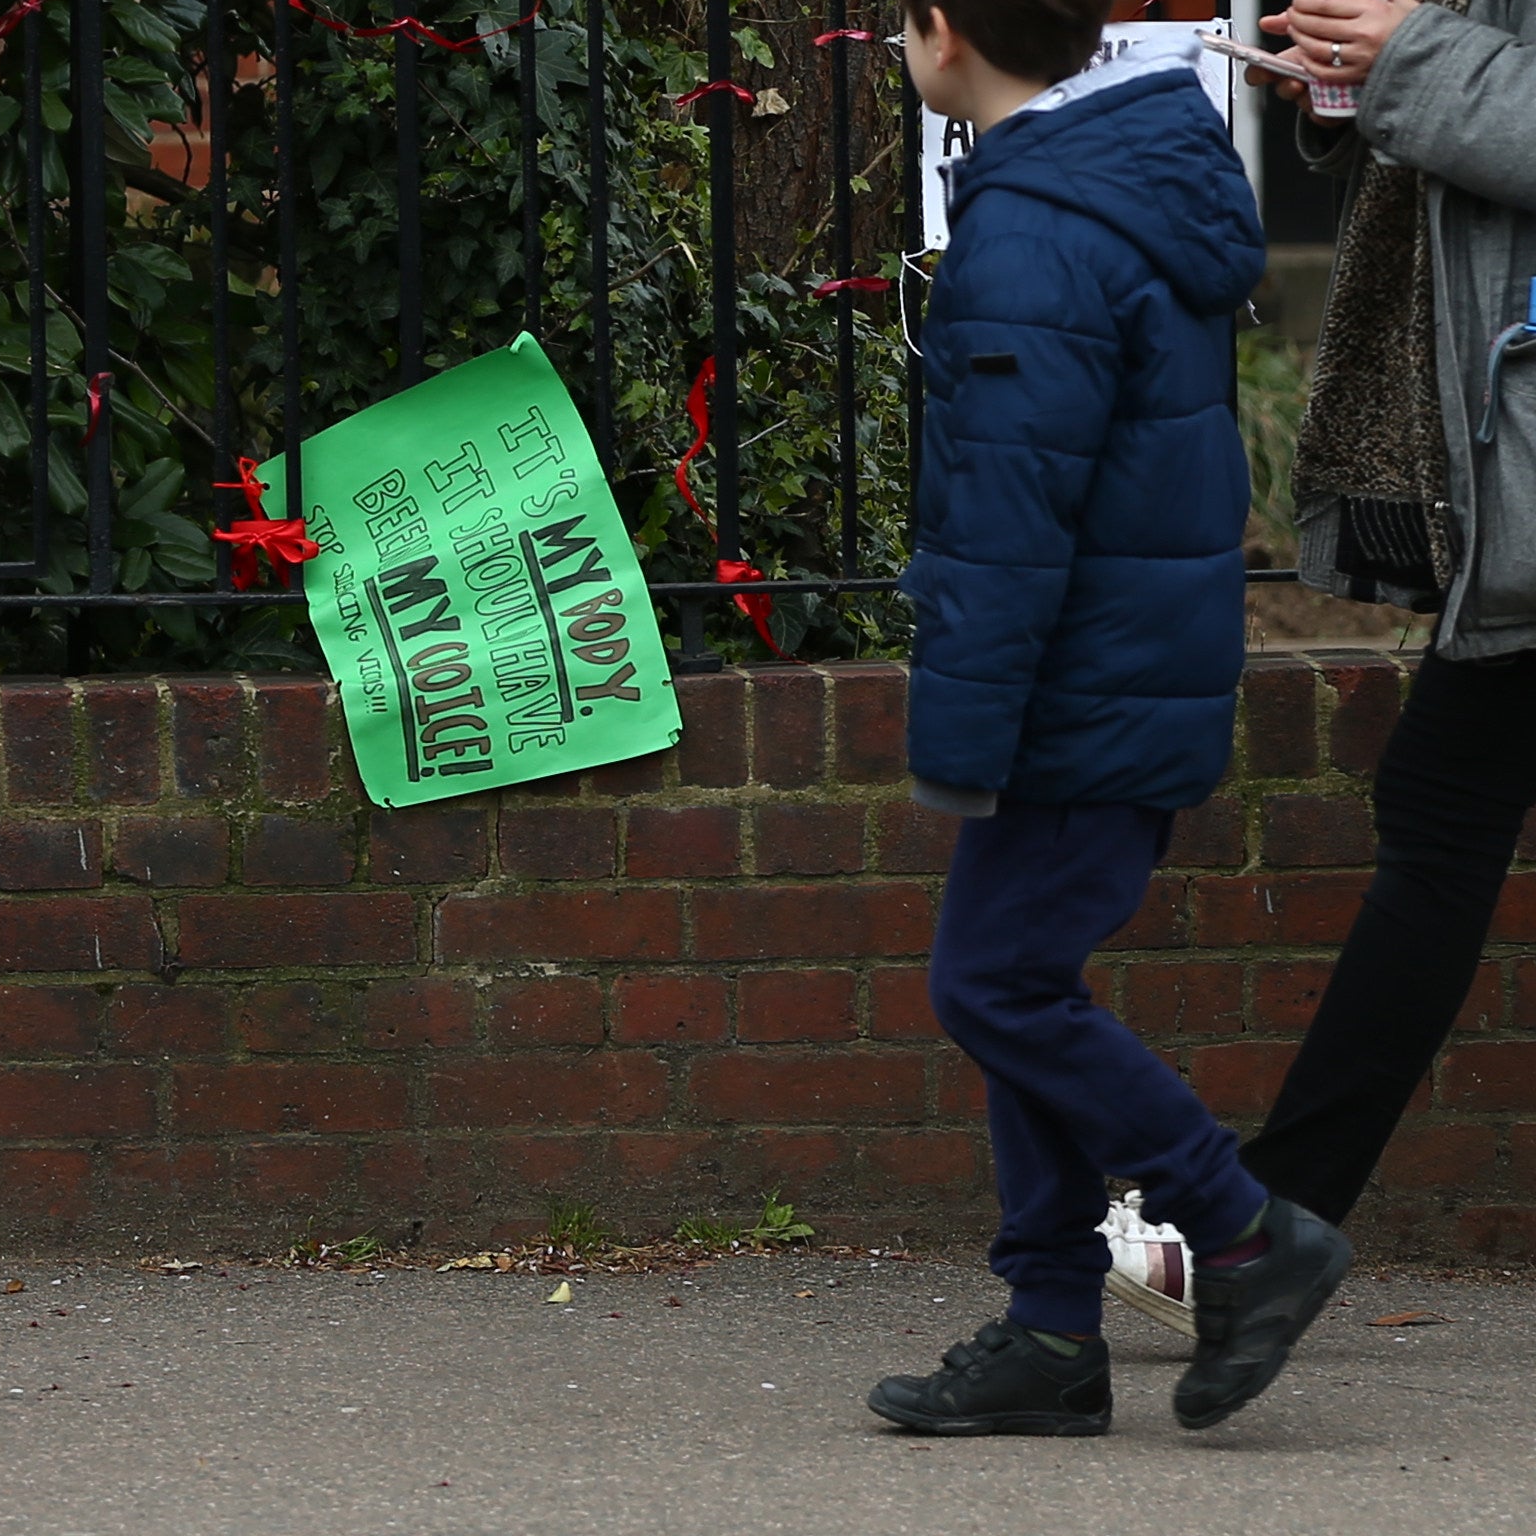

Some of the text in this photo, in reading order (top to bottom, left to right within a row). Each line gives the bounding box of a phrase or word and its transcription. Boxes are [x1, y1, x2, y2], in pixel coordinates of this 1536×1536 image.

[497, 405, 579, 517] IT'S
[303, 504, 346, 555] STOP
[531, 514, 612, 594] MY
[377, 554, 462, 642] MY
[423, 441, 566, 754] IT SHOUL HAVE
[406, 641, 495, 778] COICE!
